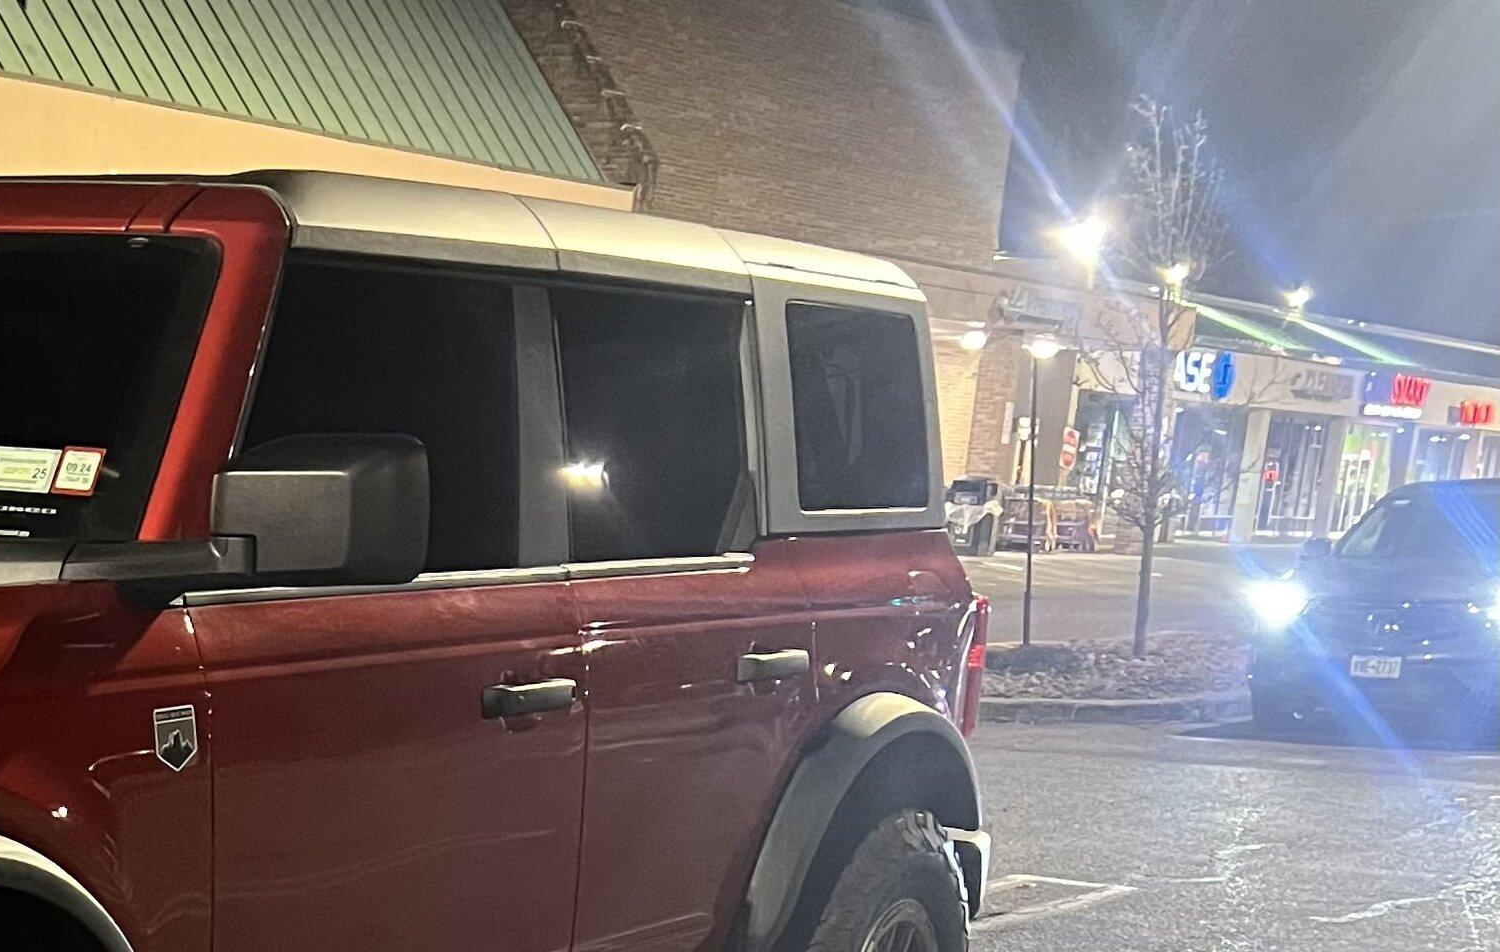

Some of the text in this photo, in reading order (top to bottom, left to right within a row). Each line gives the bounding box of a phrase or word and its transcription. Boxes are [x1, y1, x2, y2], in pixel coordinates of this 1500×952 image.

[1174, 351, 1216, 393] ASE
[31, 467, 48, 480] 25
[79, 463, 92, 473] 24
